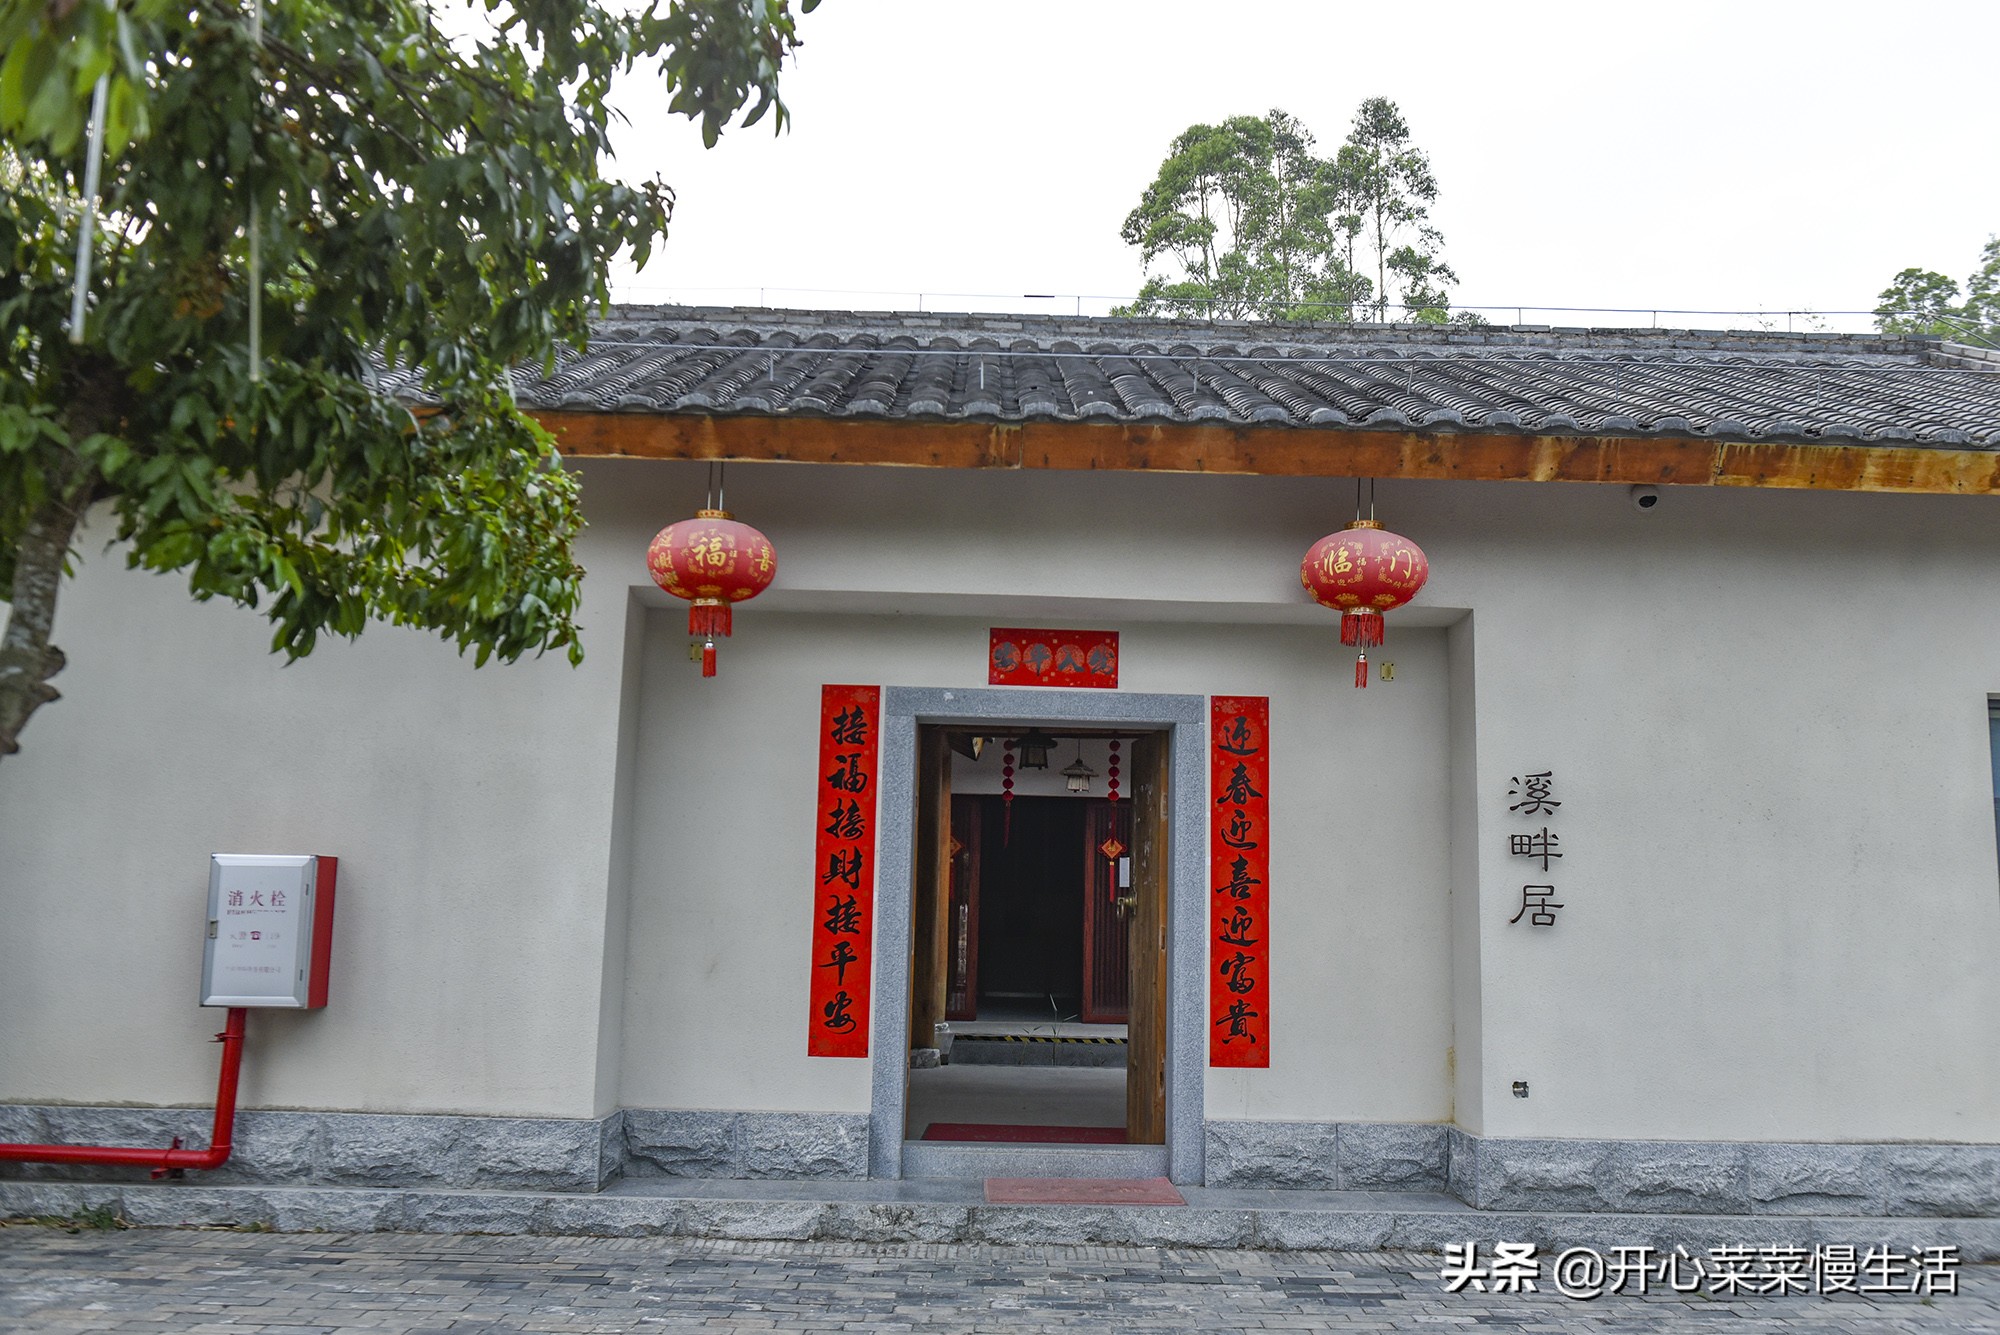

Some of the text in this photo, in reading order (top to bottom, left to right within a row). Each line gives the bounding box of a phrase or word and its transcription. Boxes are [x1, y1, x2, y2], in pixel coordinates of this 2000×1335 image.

[691, 536, 727, 568] 福
[754, 543, 775, 573] 喜
[1508, 770, 1565, 927] 溪畔居
[228, 889, 287, 908] 消火栓
